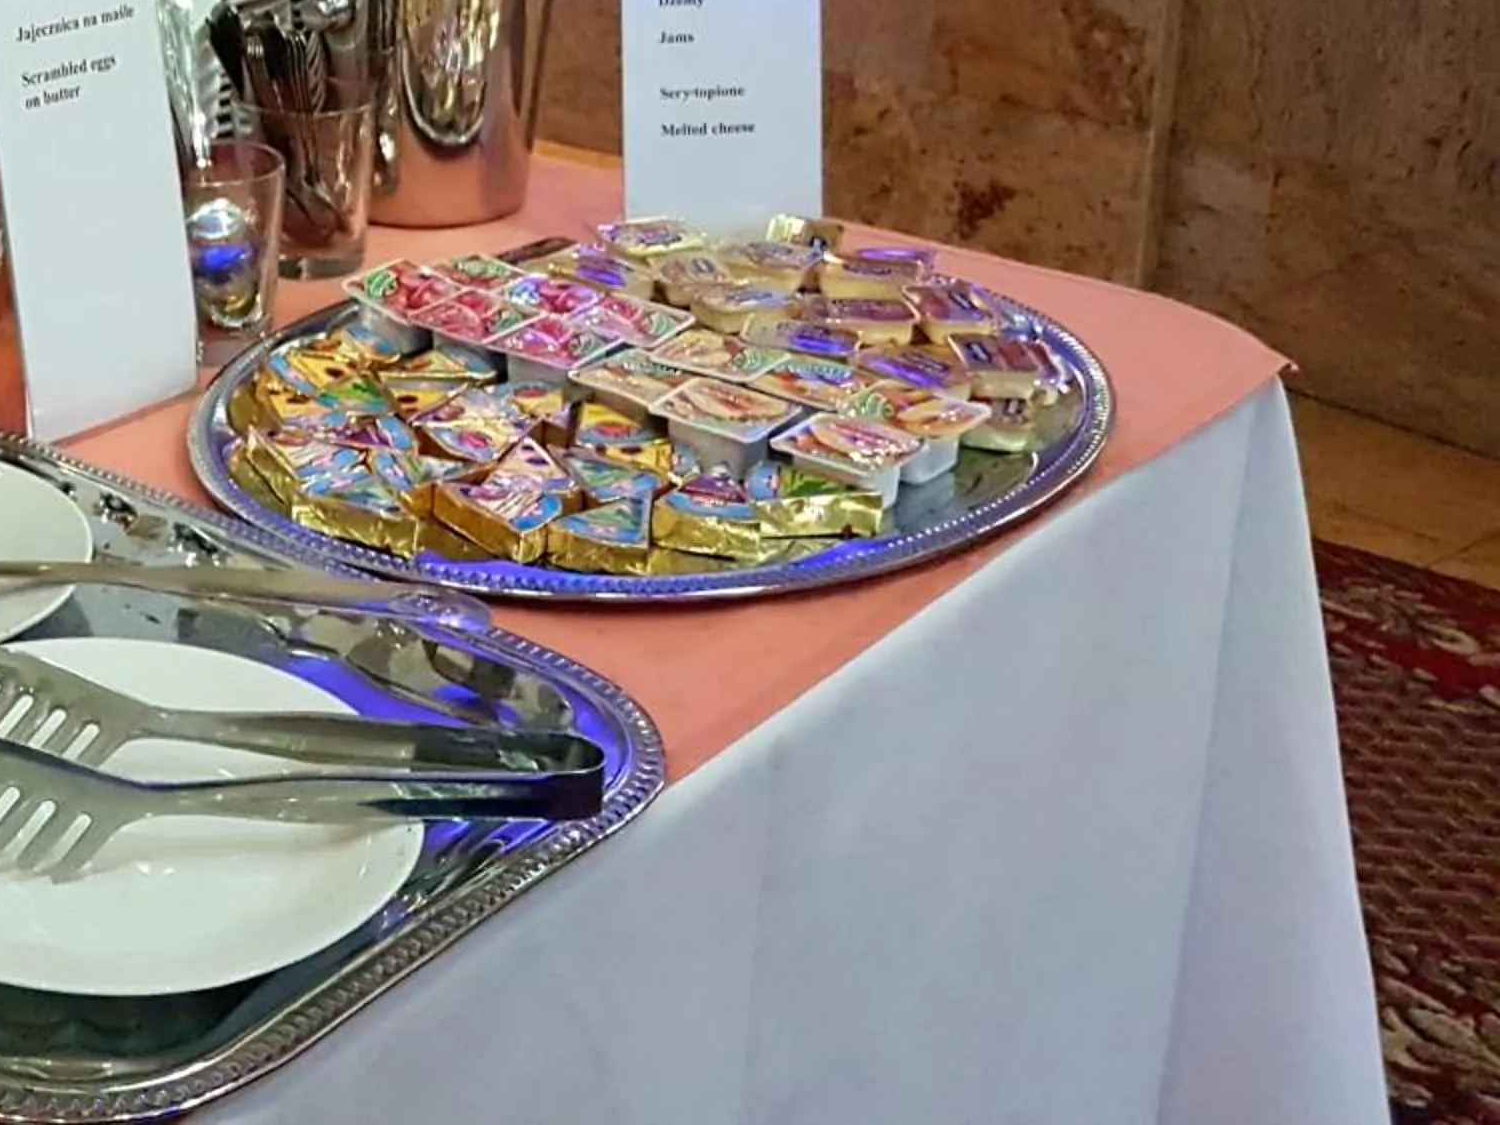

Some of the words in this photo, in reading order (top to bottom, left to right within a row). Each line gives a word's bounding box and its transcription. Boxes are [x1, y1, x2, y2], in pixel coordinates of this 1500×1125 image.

[16, 17, 79, 42] Jajecznica
[83, 12, 97, 28] na
[659, 30, 694, 44] Jams
[21, 59, 87, 87] Scrambled
[91, 56, 116, 72] eggs
[25, 95, 40, 110] on
[43, 87, 81, 105] butter
[661, 123, 707, 137] Melted
[711, 122, 755, 135] cheese
